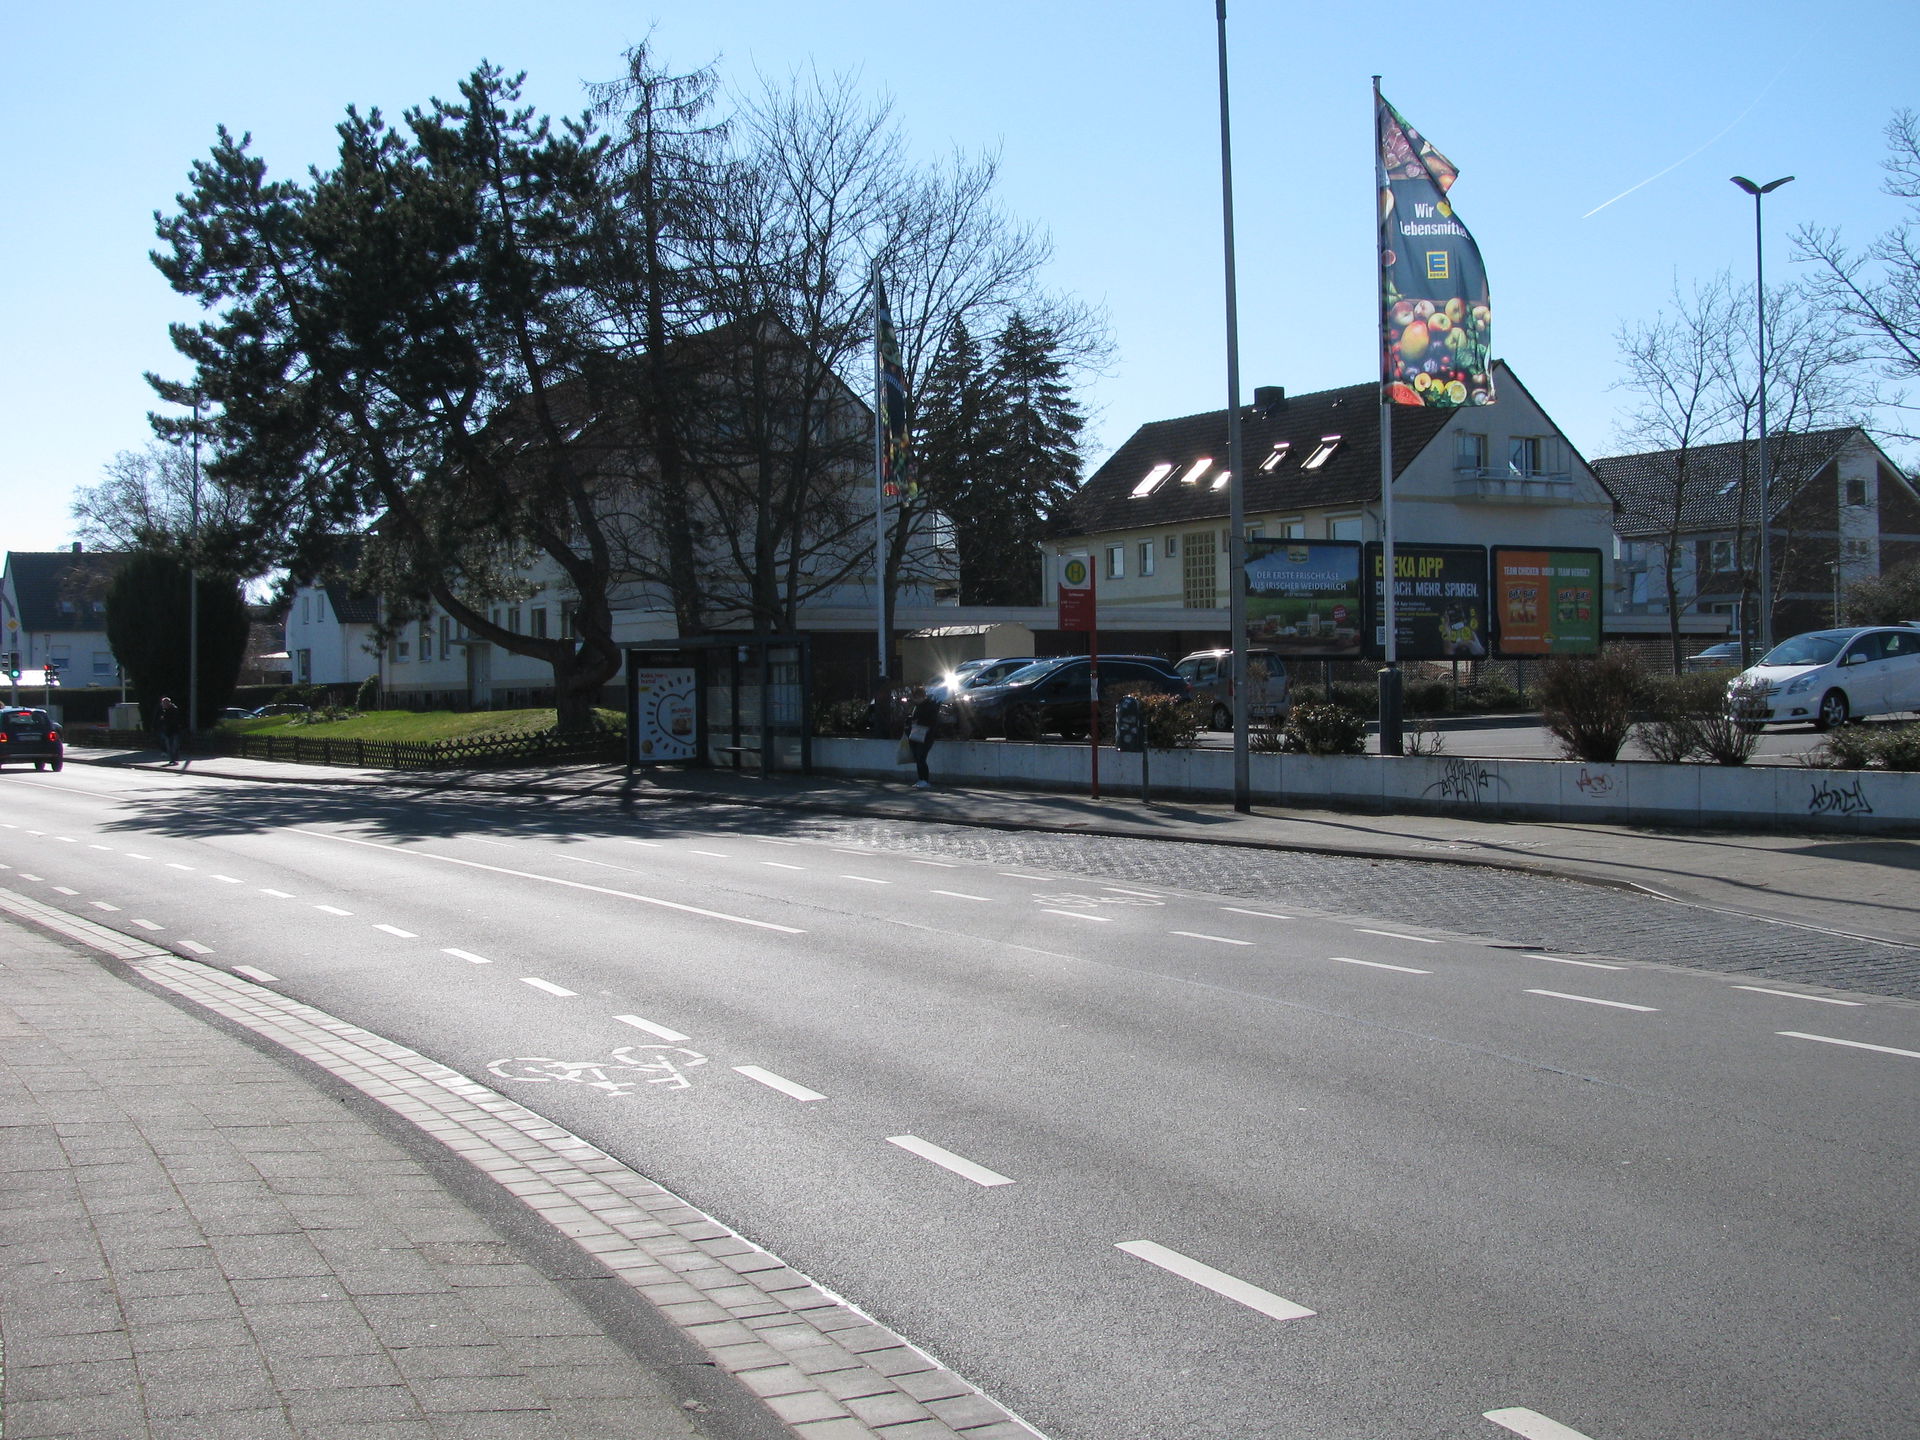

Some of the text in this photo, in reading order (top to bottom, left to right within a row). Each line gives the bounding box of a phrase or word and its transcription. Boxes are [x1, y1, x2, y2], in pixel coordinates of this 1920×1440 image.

[1414, 203, 1434, 218] Wir
[1375, 555, 1444, 578] EEKA APP
[1504, 566, 1517, 576] TEAM
[1558, 568, 1570, 577] TEAM
[1256, 571, 1271, 579] DER
[1273, 571, 1294, 580] ERSTE
[1249, 581, 1346, 591] AUS IRISCHER WEIDEMILCH
[1375, 581, 1478, 597] EIACH. MEHR. SPAREN.
